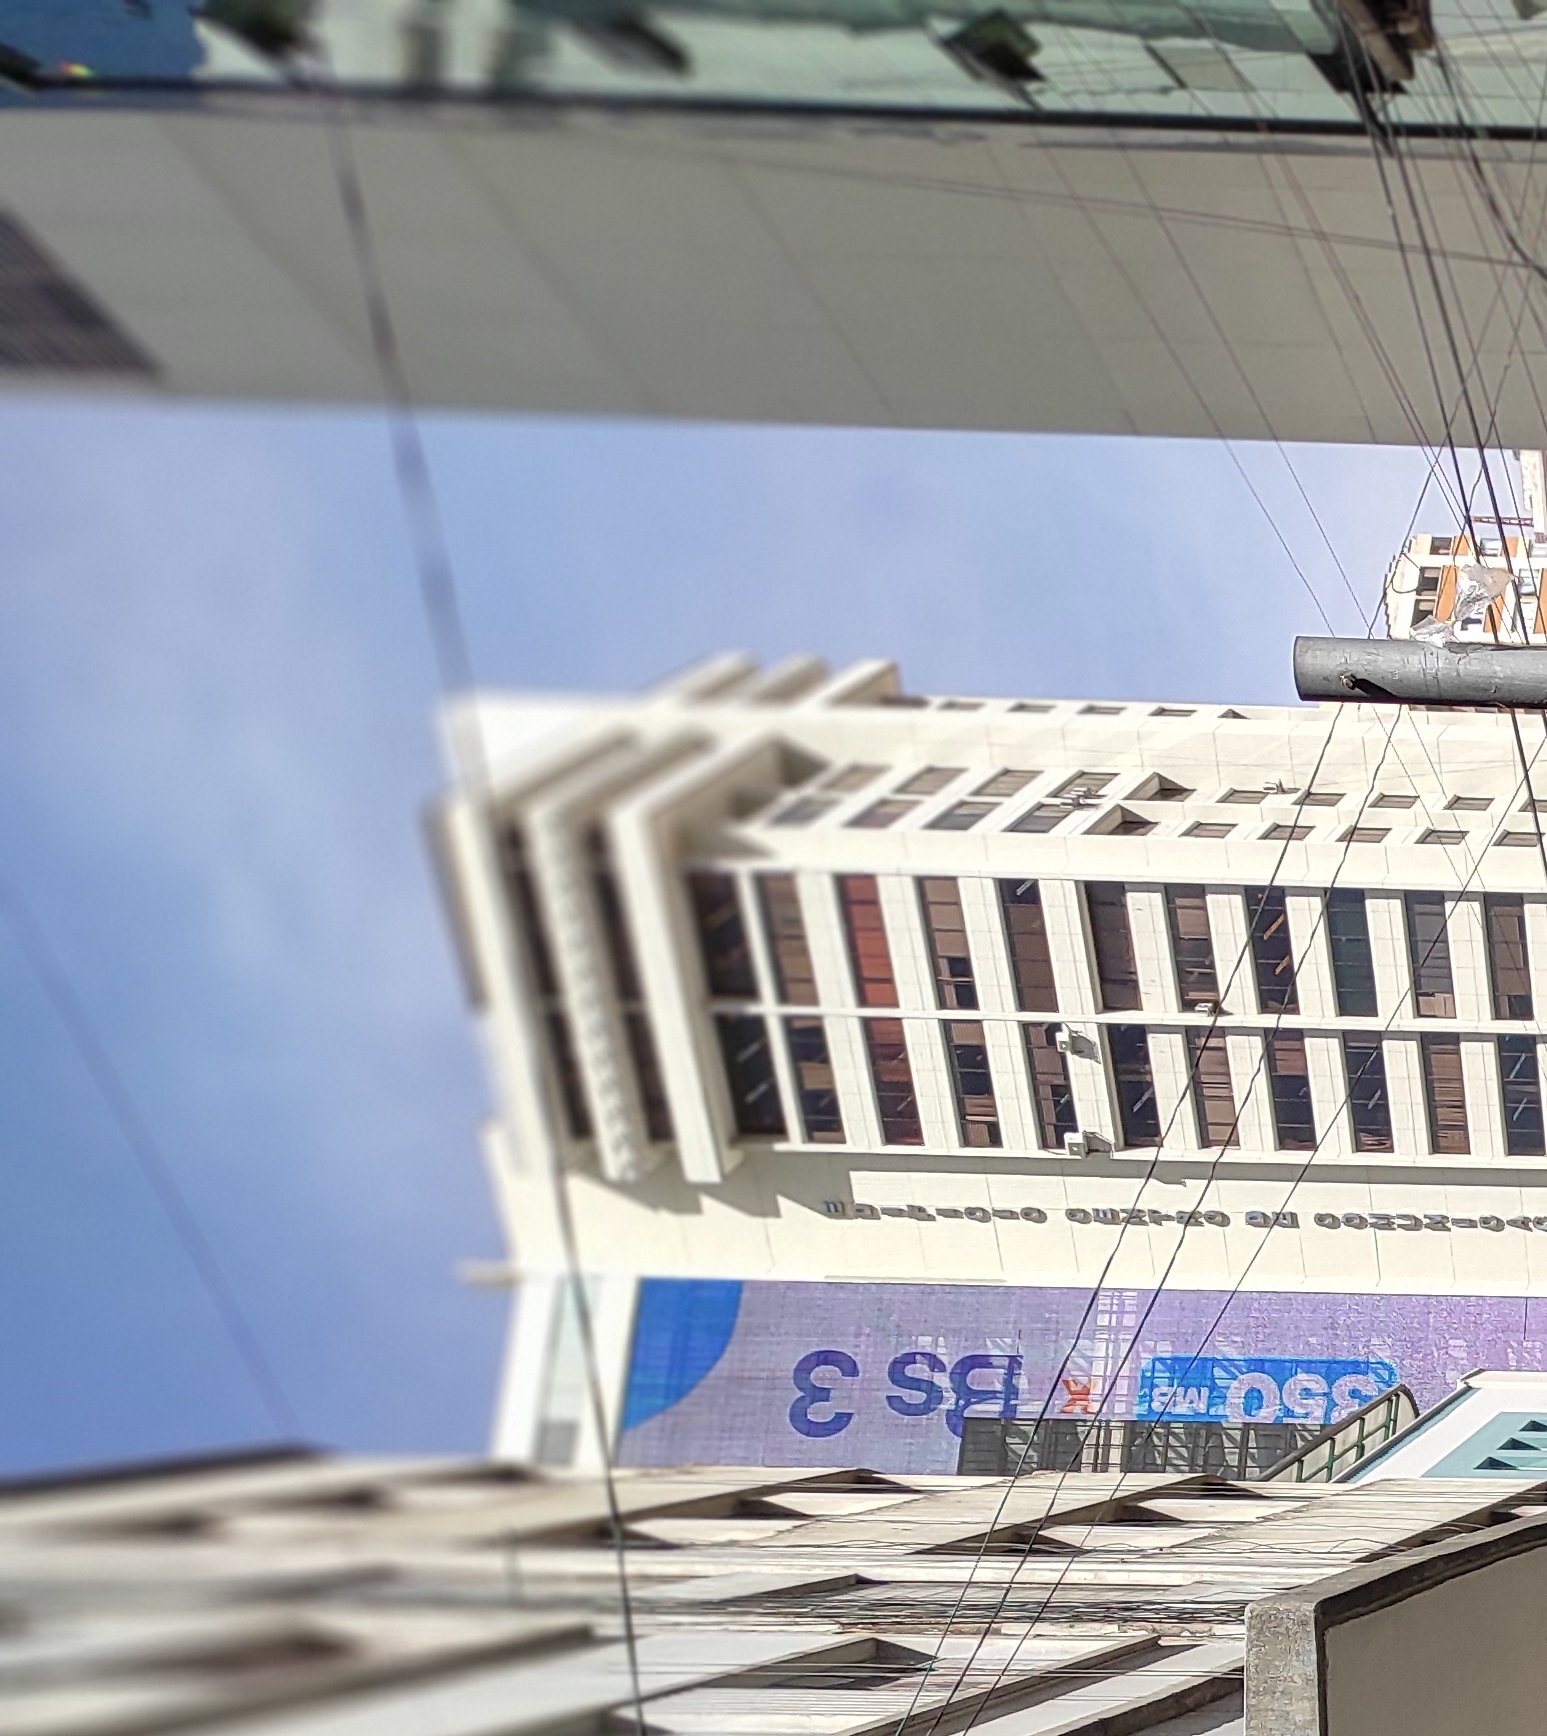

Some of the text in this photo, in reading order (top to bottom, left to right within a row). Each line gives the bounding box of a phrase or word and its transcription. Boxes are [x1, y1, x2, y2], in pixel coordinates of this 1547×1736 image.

[825, 1200, 1048, 1224] EDIFICIO
[1245, 1211, 1300, 1229] DE
[788, 1349, 860, 1438] 3
[885, 1351, 1024, 1438] Bs
